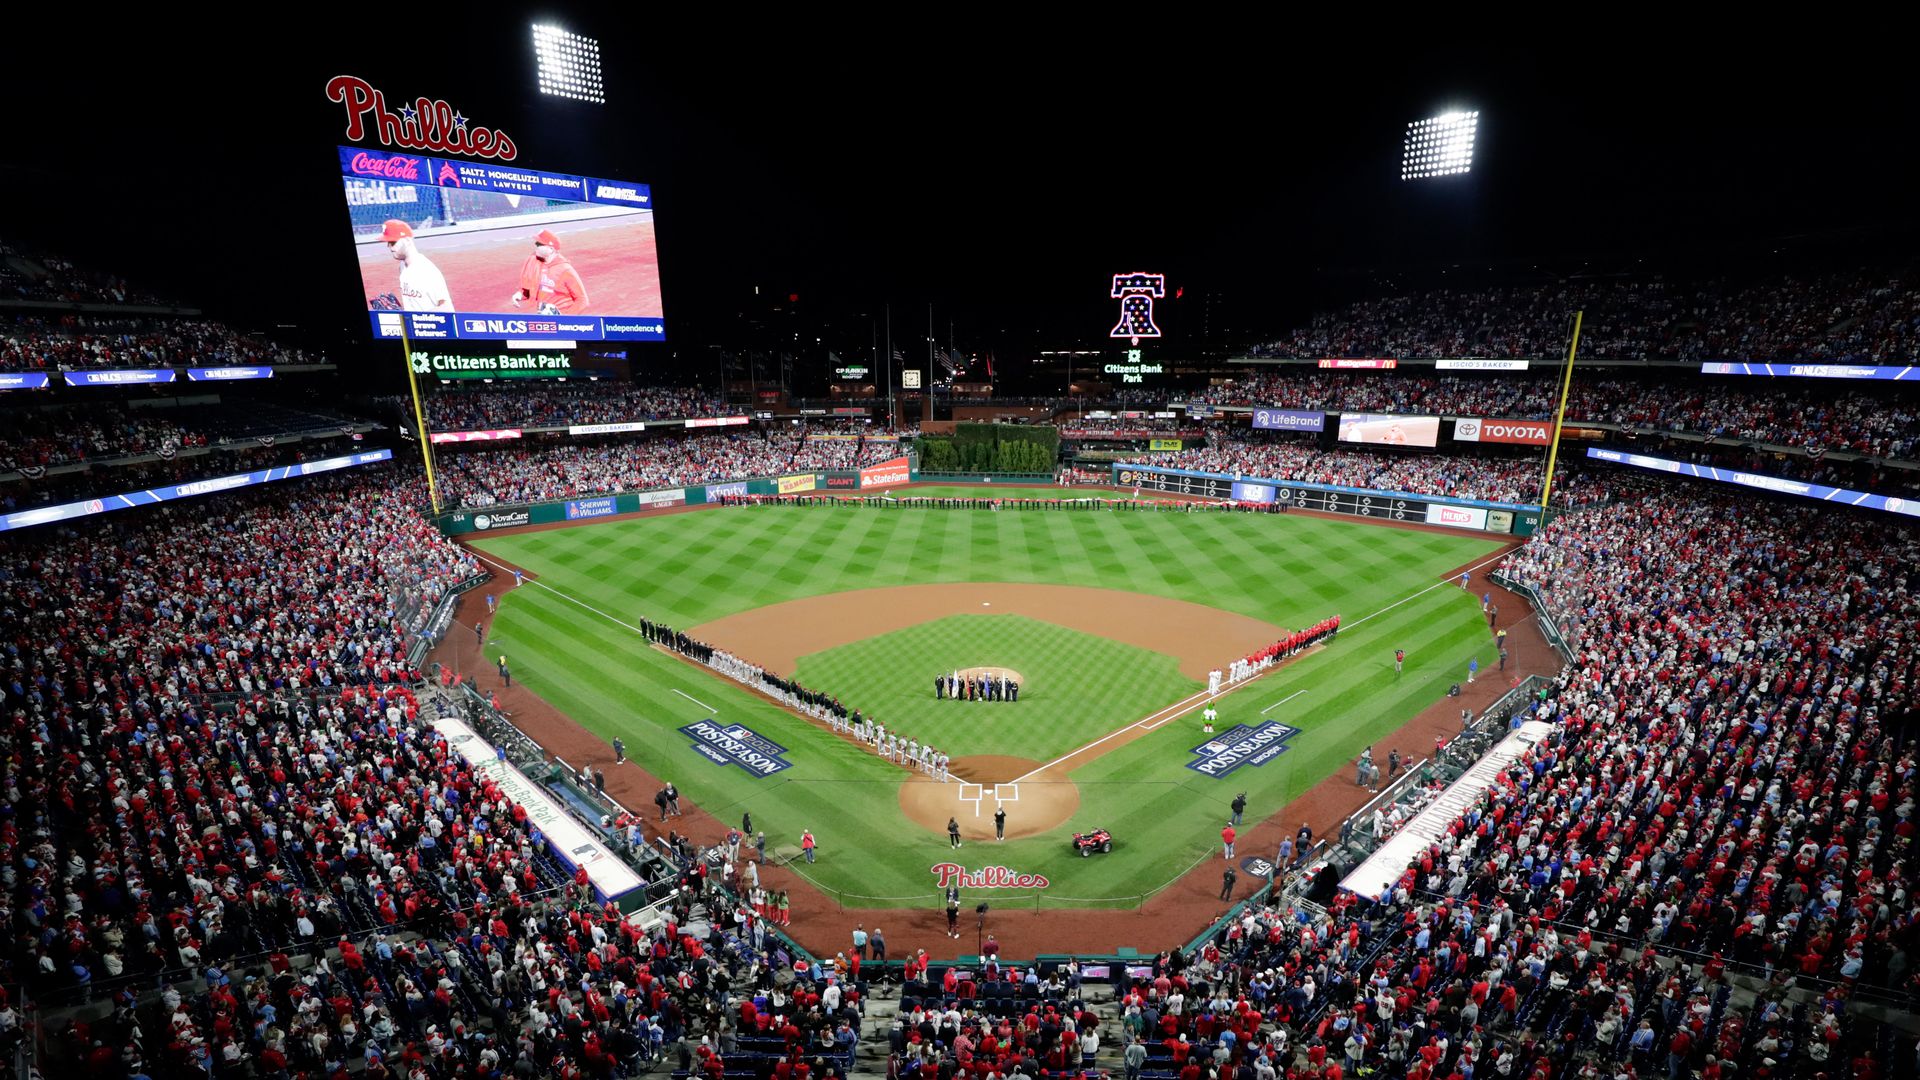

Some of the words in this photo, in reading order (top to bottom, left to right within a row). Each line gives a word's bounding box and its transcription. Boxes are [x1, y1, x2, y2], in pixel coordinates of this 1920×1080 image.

[326, 75, 517, 161] Phillies
[351, 152, 419, 180] Coca-Cola
[460, 167, 485, 177] SALTZ
[488, 170, 539, 183] MONGELUZZI
[542, 177, 581, 189] BENDESKY
[462, 177, 487, 186] TRIAL
[493, 181, 532, 191] LAWYERS
[412, 314, 446, 324] Building
[413, 322, 437, 330] brave
[488, 320, 527, 333] NLCS
[528, 323, 557, 331] 2023
[606, 324, 655, 333] Independence
[433, 355, 497, 370] Citizens
[499, 354, 537, 369] Bank
[539, 354, 570, 368] Park
[1104, 364, 1139, 373] Citizens
[1140, 364, 1162, 373] Bank
[101, 373, 121, 382] NLCS
[1123, 373, 1142, 382] Park
[1803, 366, 1828, 376] NLCS
[1272, 415, 1320, 427] LifeBrand
[1484, 425, 1547, 439] TOYOTA
[709, 485, 745, 499] xfinity
[579, 500, 611, 509] SHERWIN
[490, 512, 529, 523] NovaCare
[579, 506, 612, 517] WILLIAMS
[1525, 517, 1538, 525] 330
[1221, 727, 1253, 745] 2023
[688, 722, 781, 774] POSTSEASON
[742, 735, 779, 756] 2023
[1197, 723, 1291, 774] POSTSEASON
[515, 790, 540, 809] Bank
[536, 806, 559, 825] Park
[931, 863, 1049, 888] Phillies
